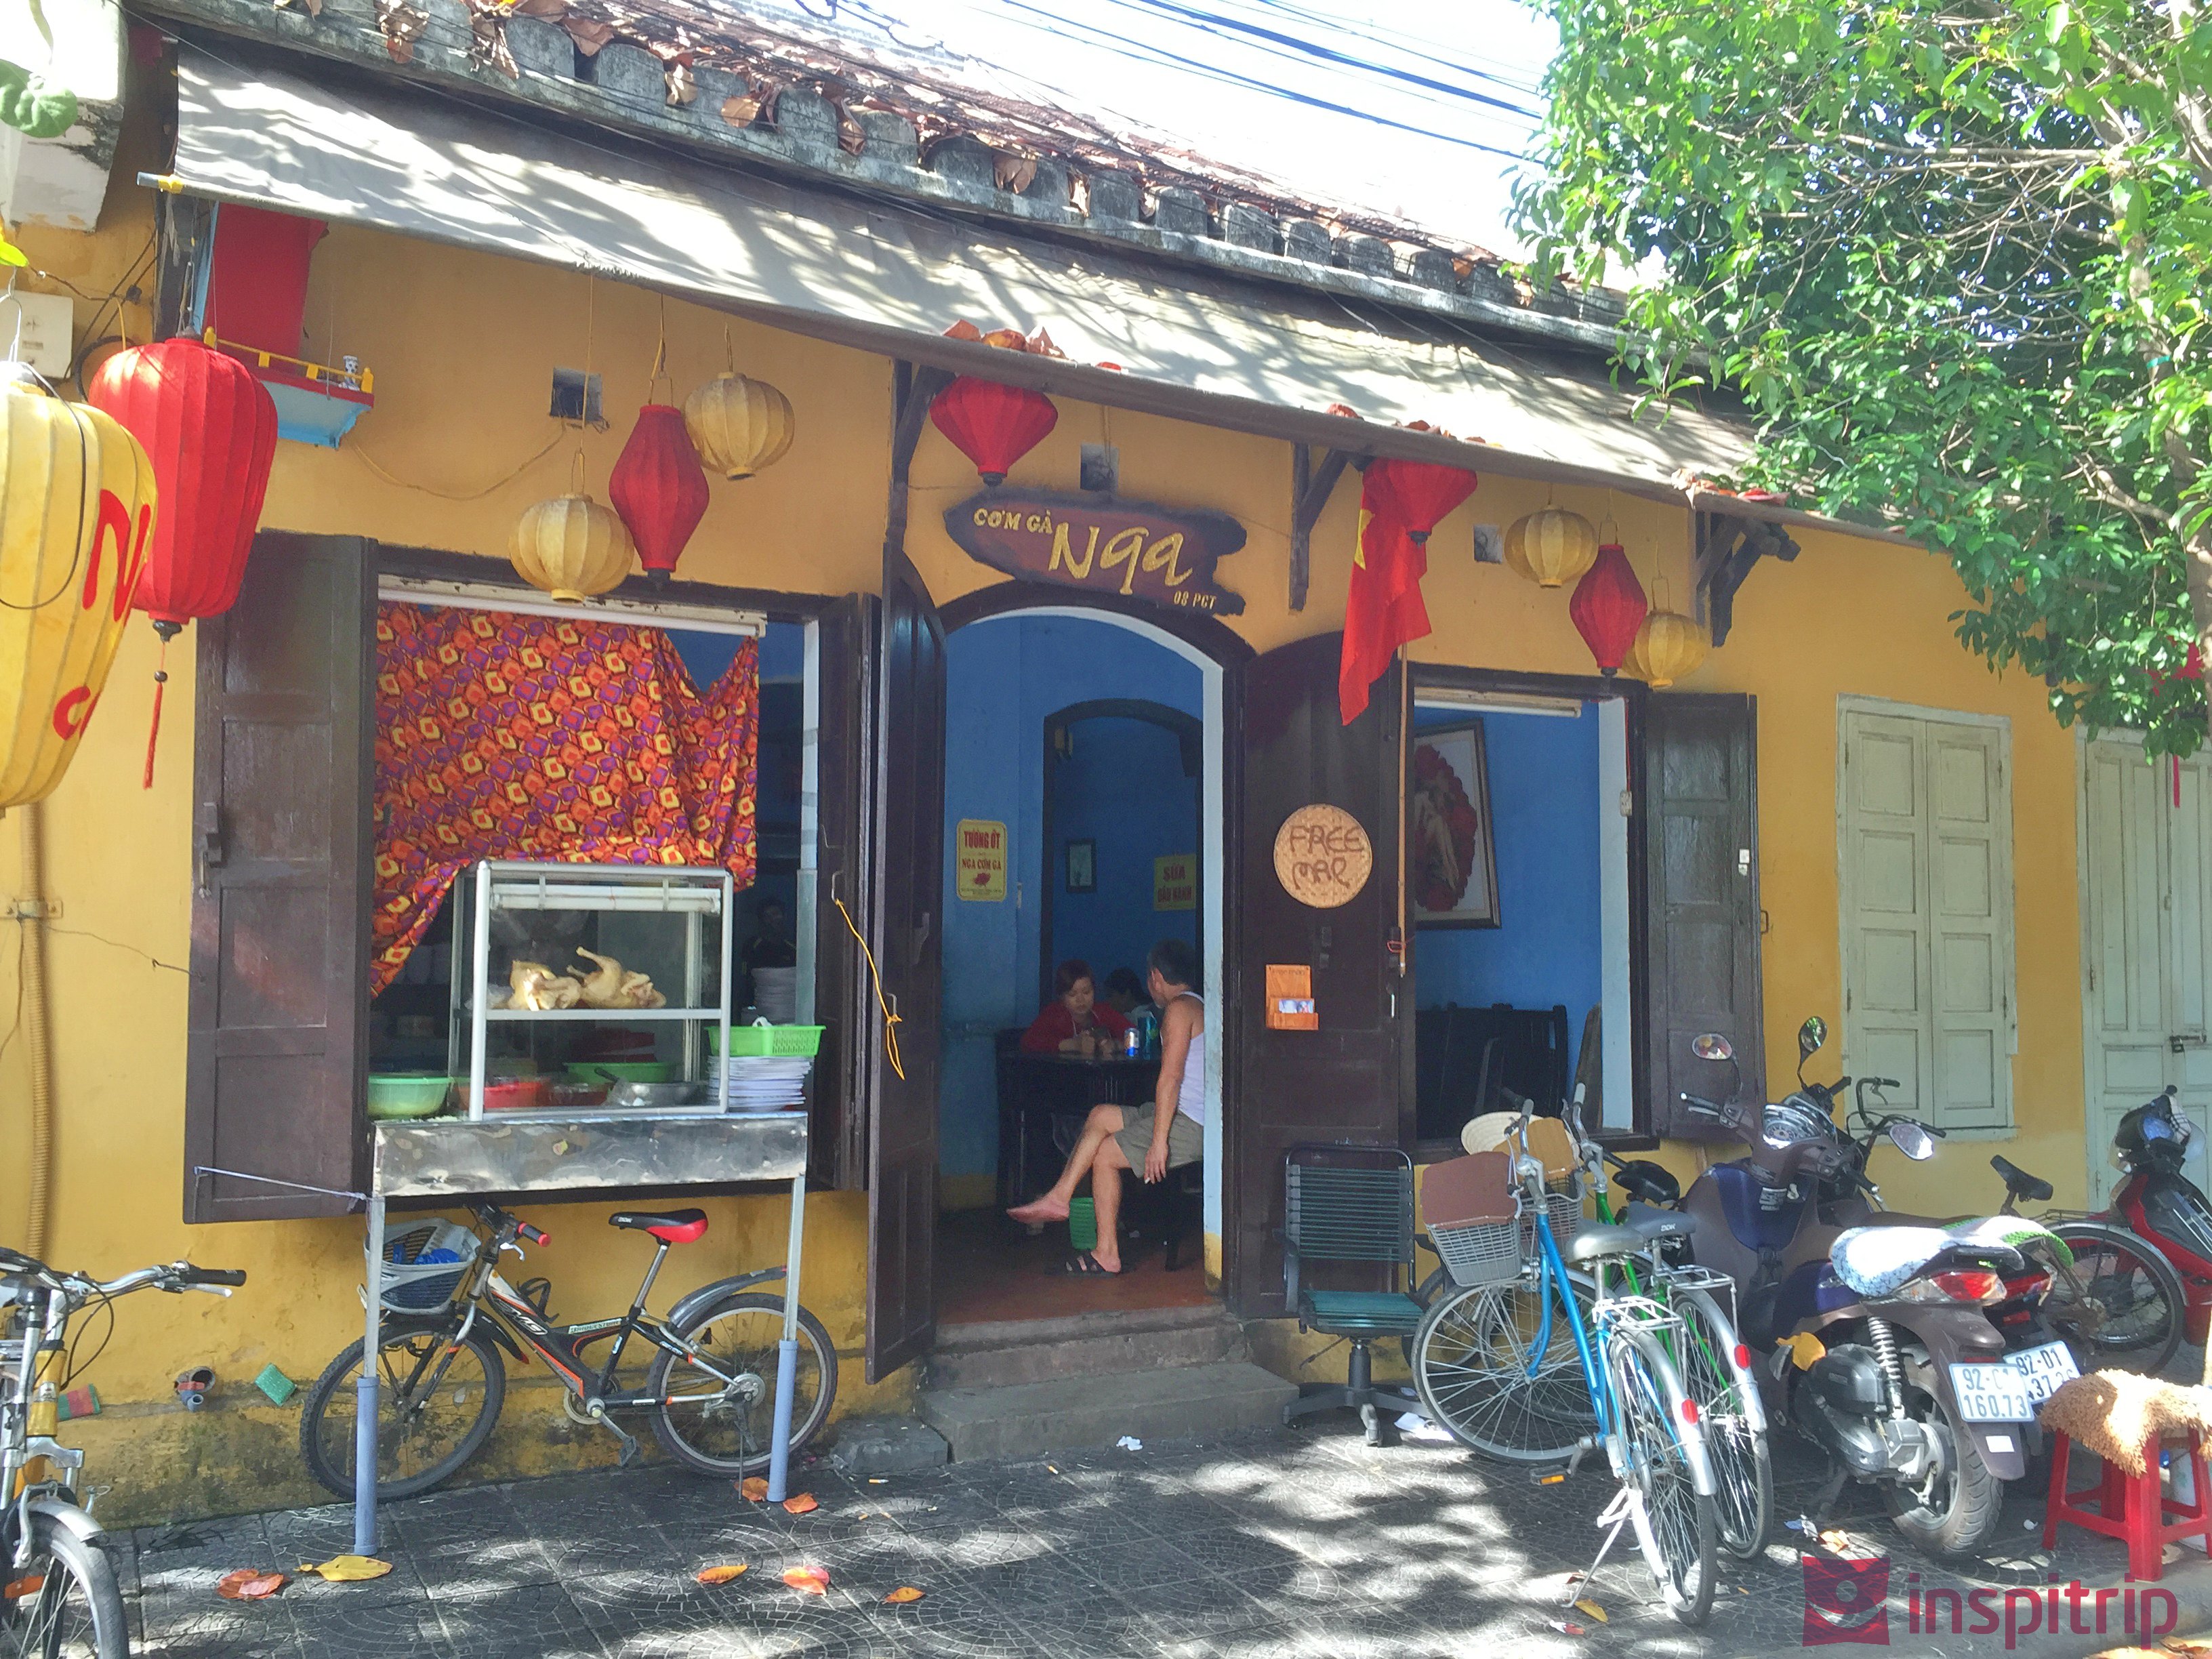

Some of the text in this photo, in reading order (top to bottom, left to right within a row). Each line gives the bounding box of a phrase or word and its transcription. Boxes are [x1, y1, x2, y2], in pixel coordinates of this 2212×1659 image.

[974, 508, 1053, 534] CƠM GÀ
[1048, 523, 1193, 595] Nga
[1173, 590, 1217, 609] 08 PCT
[1289, 825, 1366, 857] FREE
[1292, 857, 1351, 890] MAP
[1963, 1395, 2027, 1417] 160.73
